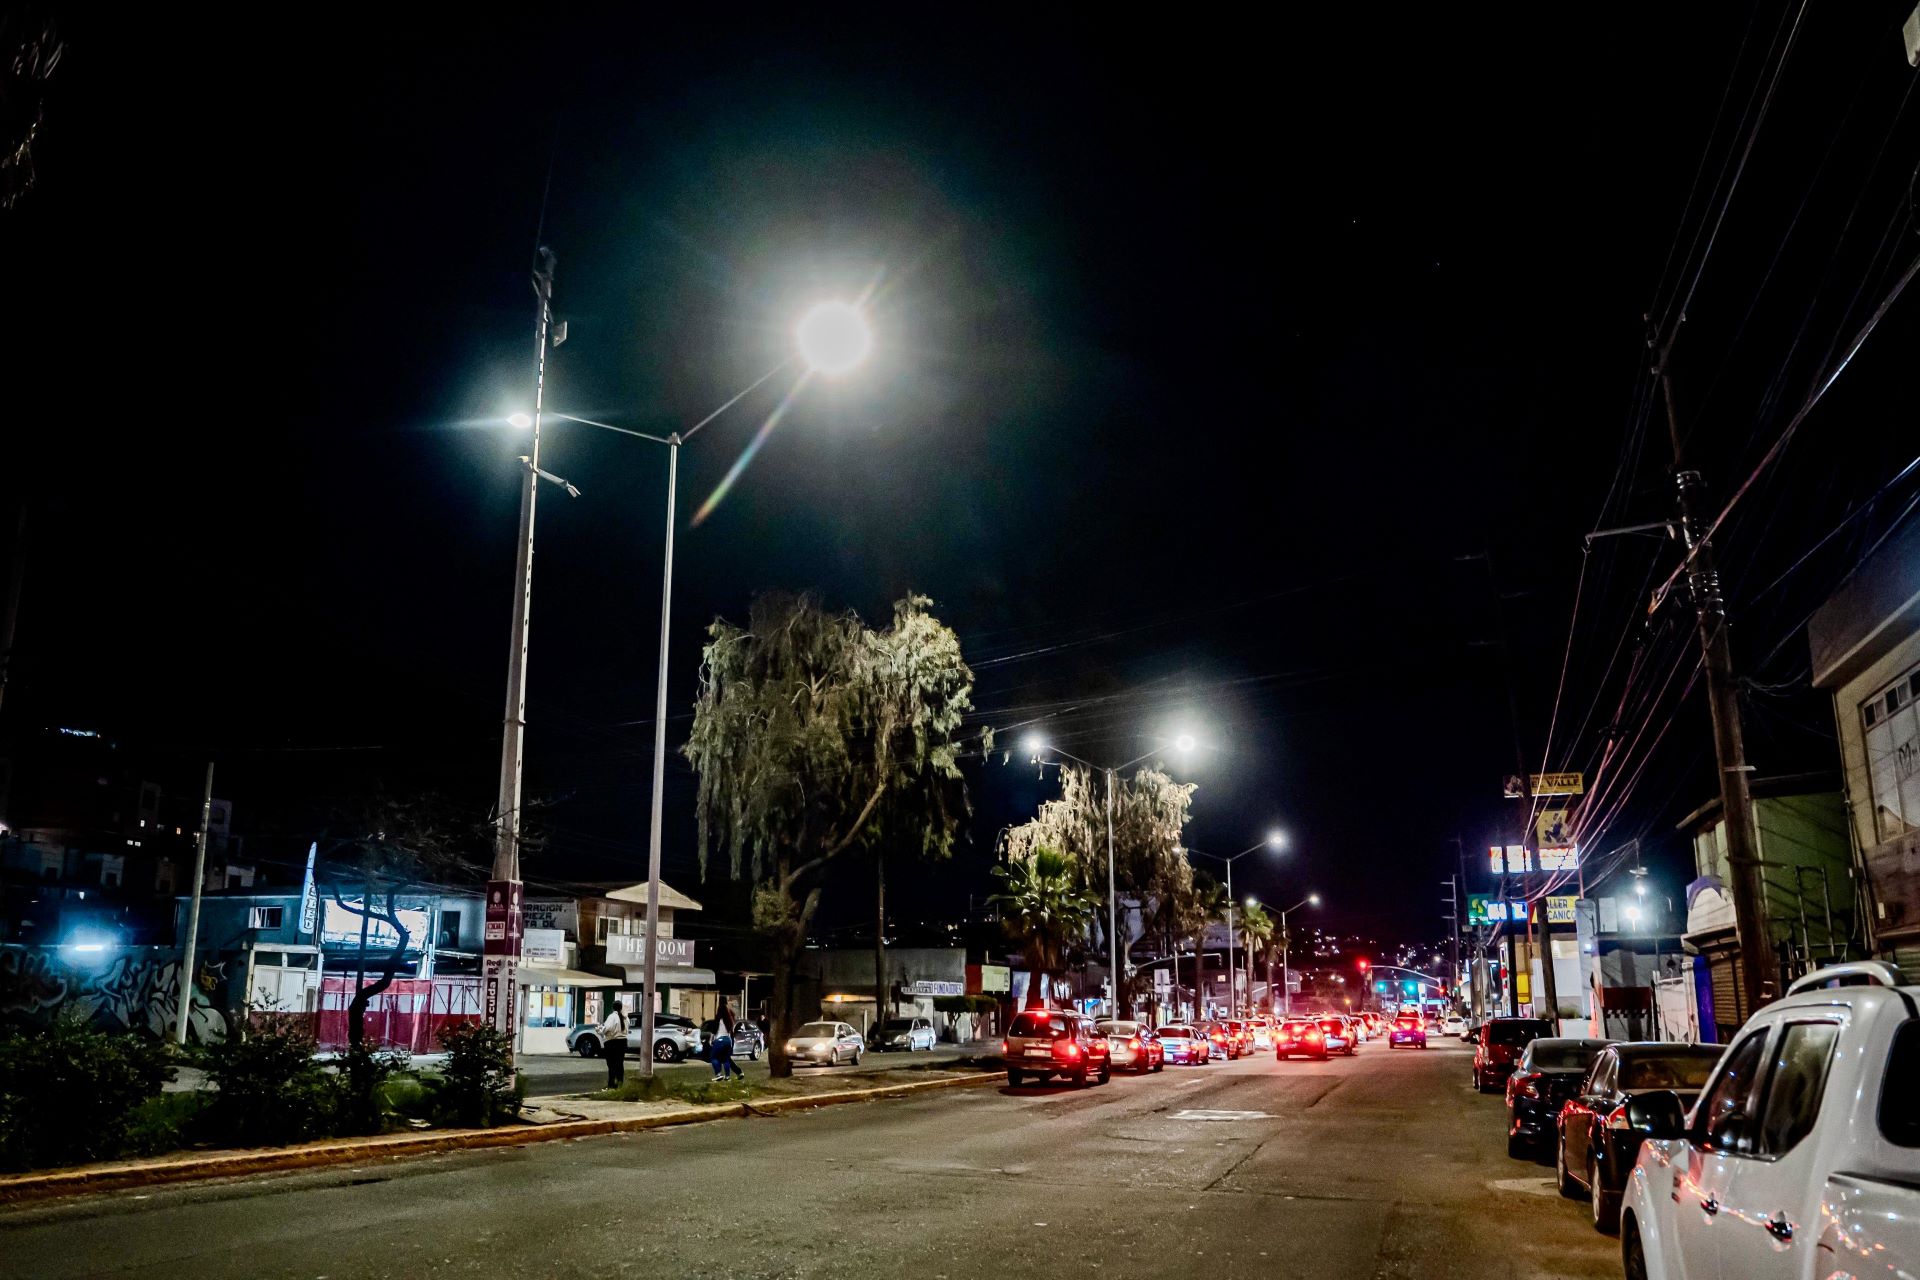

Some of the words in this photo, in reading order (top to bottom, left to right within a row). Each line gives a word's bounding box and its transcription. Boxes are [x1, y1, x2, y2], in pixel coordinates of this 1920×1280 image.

[1546, 777, 1580, 787] VALLE
[617, 937, 643, 953] THE
[658, 940, 687, 956] OOM
[487, 959, 501, 967] Red
[487, 981, 497, 1013] cuida
